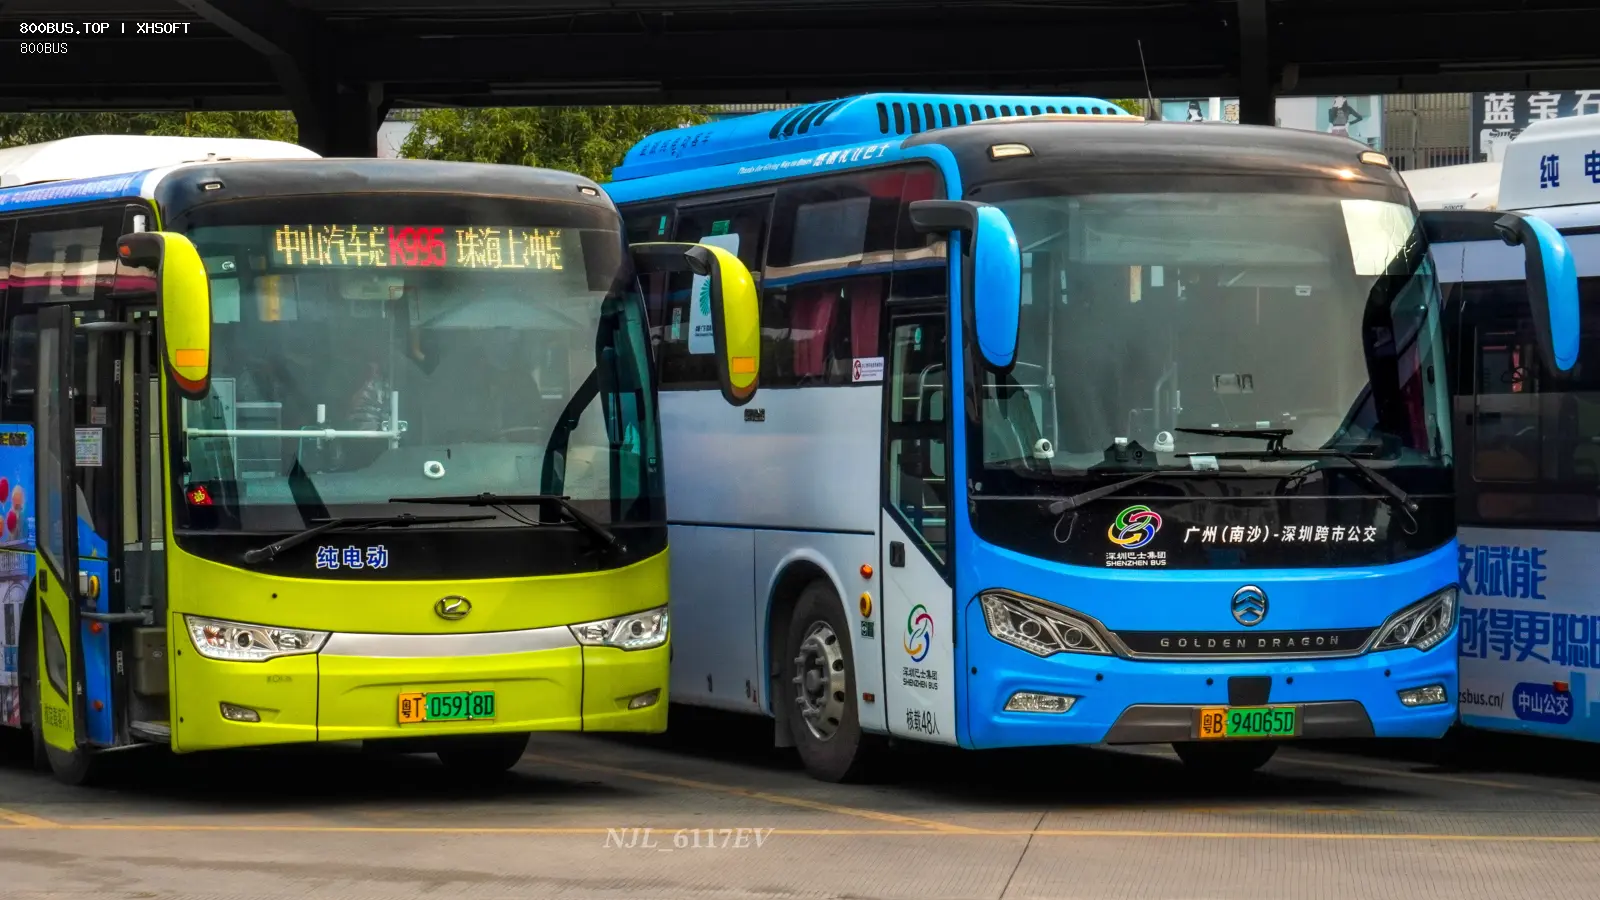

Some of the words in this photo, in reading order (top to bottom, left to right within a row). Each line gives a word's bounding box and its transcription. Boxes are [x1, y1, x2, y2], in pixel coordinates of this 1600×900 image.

[1483, 89, 1600, 124] 蓝宝石
[388, 226, 447, 267] K995
[315, 545, 388, 569] 纯电动
[1106, 551, 1166, 560] 深圳巴士集团
[1160, 638, 1246, 648] GOLDEN
[1258, 636, 1339, 647] DRAGON
[903, 666, 938, 680] 深圳巴士集团
[903, 678, 928, 688] SHENZHEN
[928, 681, 938, 690] BUS
[1518, 691, 1569, 716] 中山公交
[906, 708, 940, 735] 核载48人
